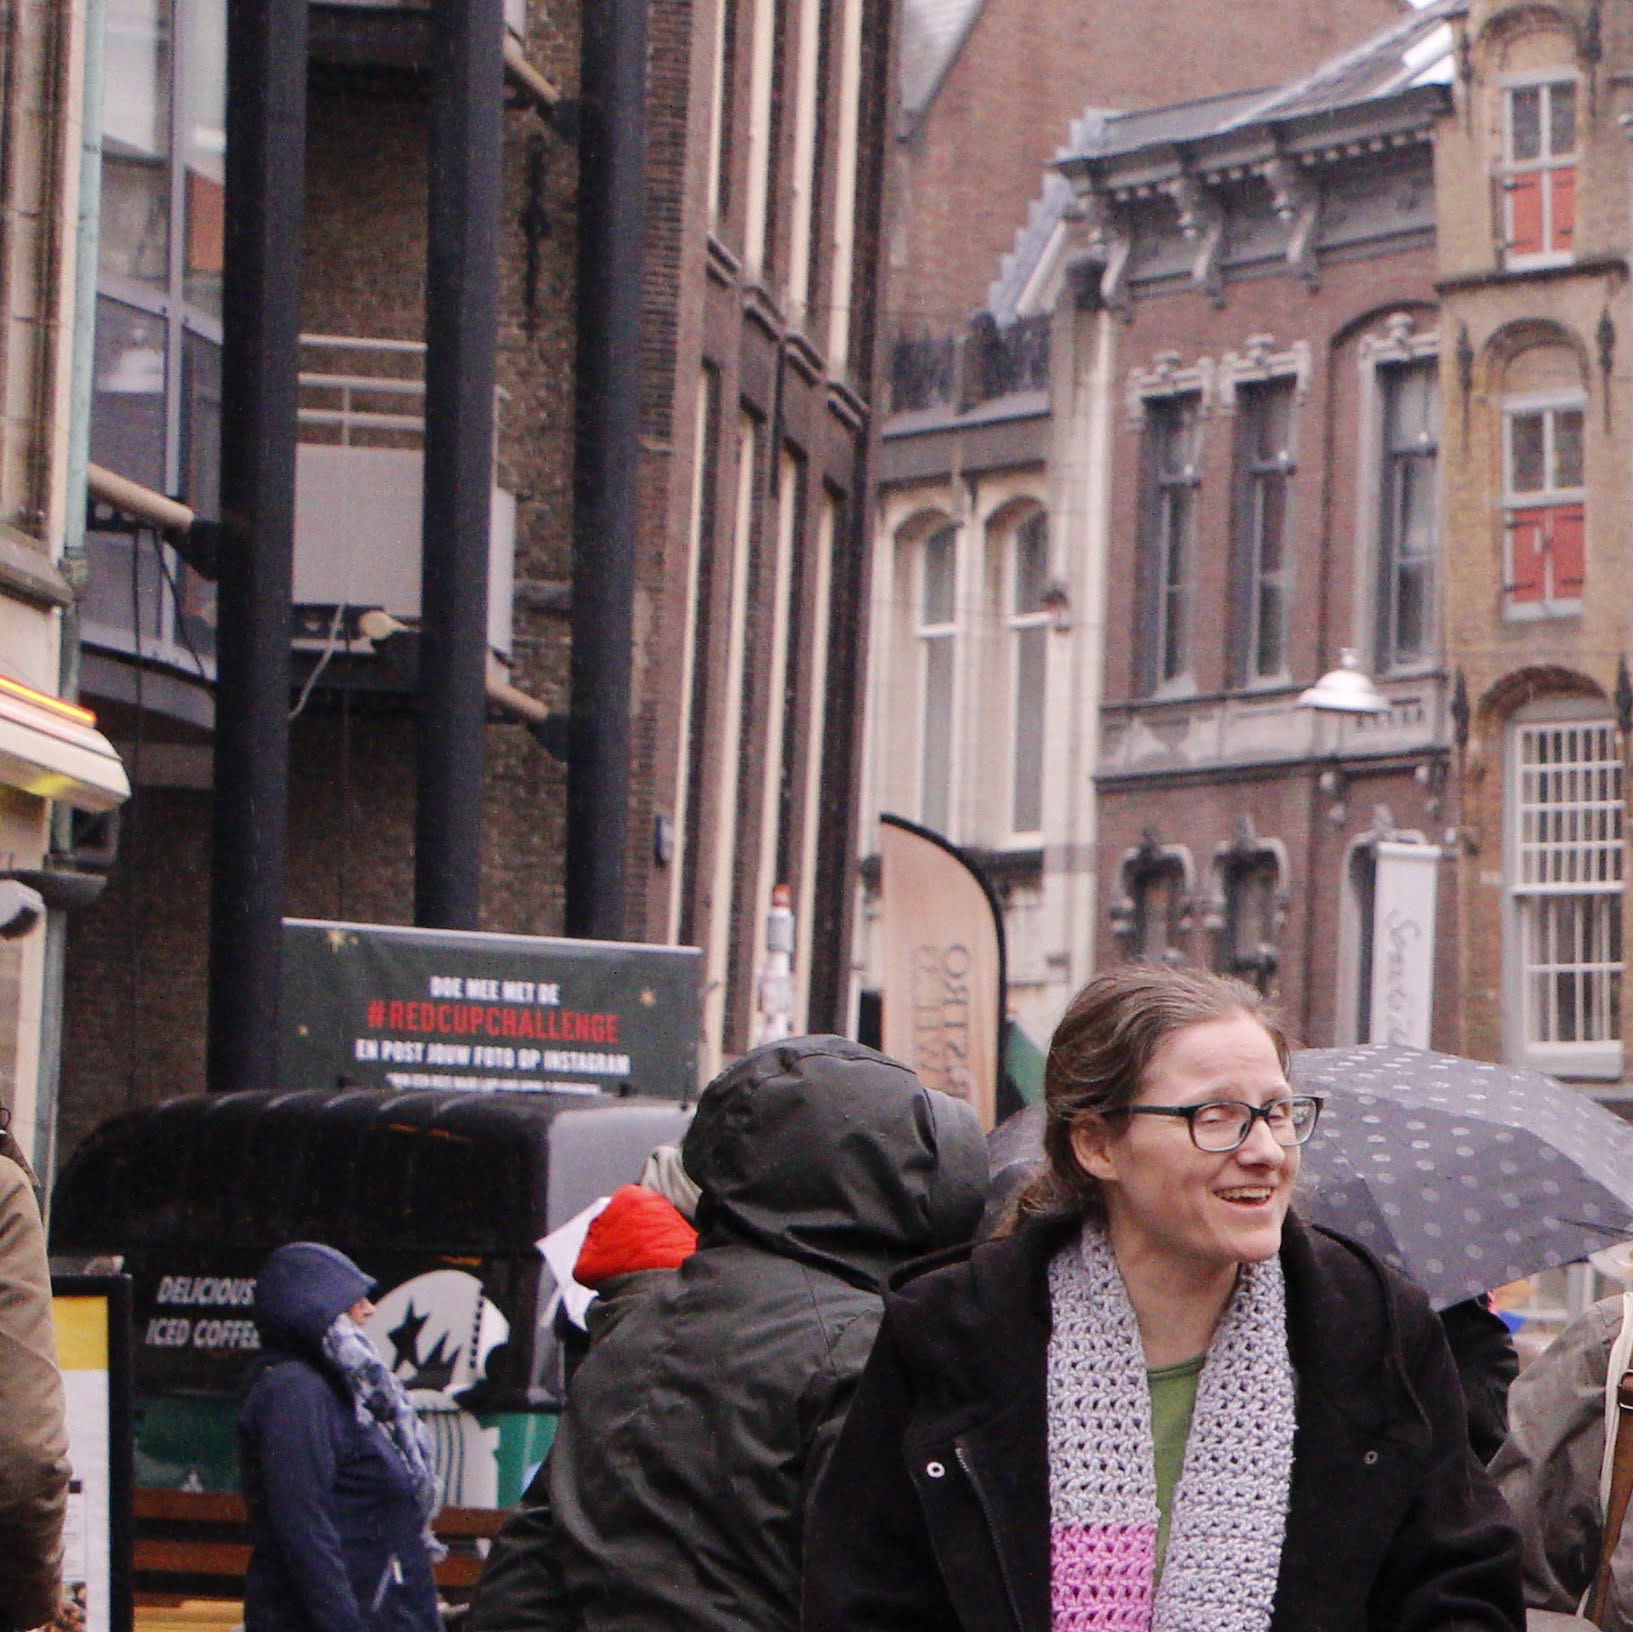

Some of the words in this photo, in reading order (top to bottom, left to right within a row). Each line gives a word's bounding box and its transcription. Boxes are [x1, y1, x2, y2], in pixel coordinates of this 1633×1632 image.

[429, 975, 463, 998] DOE
[464, 976, 500, 1000] MEE
[501, 978, 536, 1002] MET
[537, 982, 561, 1005] DE
[367, 999, 620, 1044] #REDCUPCHALLENGE
[354, 1038, 380, 1061] EN
[380, 1040, 425, 1064] POST
[425, 1043, 472, 1066] JOUW
[472, 1045, 516, 1069] FOTO
[516, 1048, 542, 1071] OP
[543, 1050, 631, 1075] INSTAGRAM
[157, 1275, 257, 1305] DELICIOUS
[145, 1318, 190, 1347] ICED
